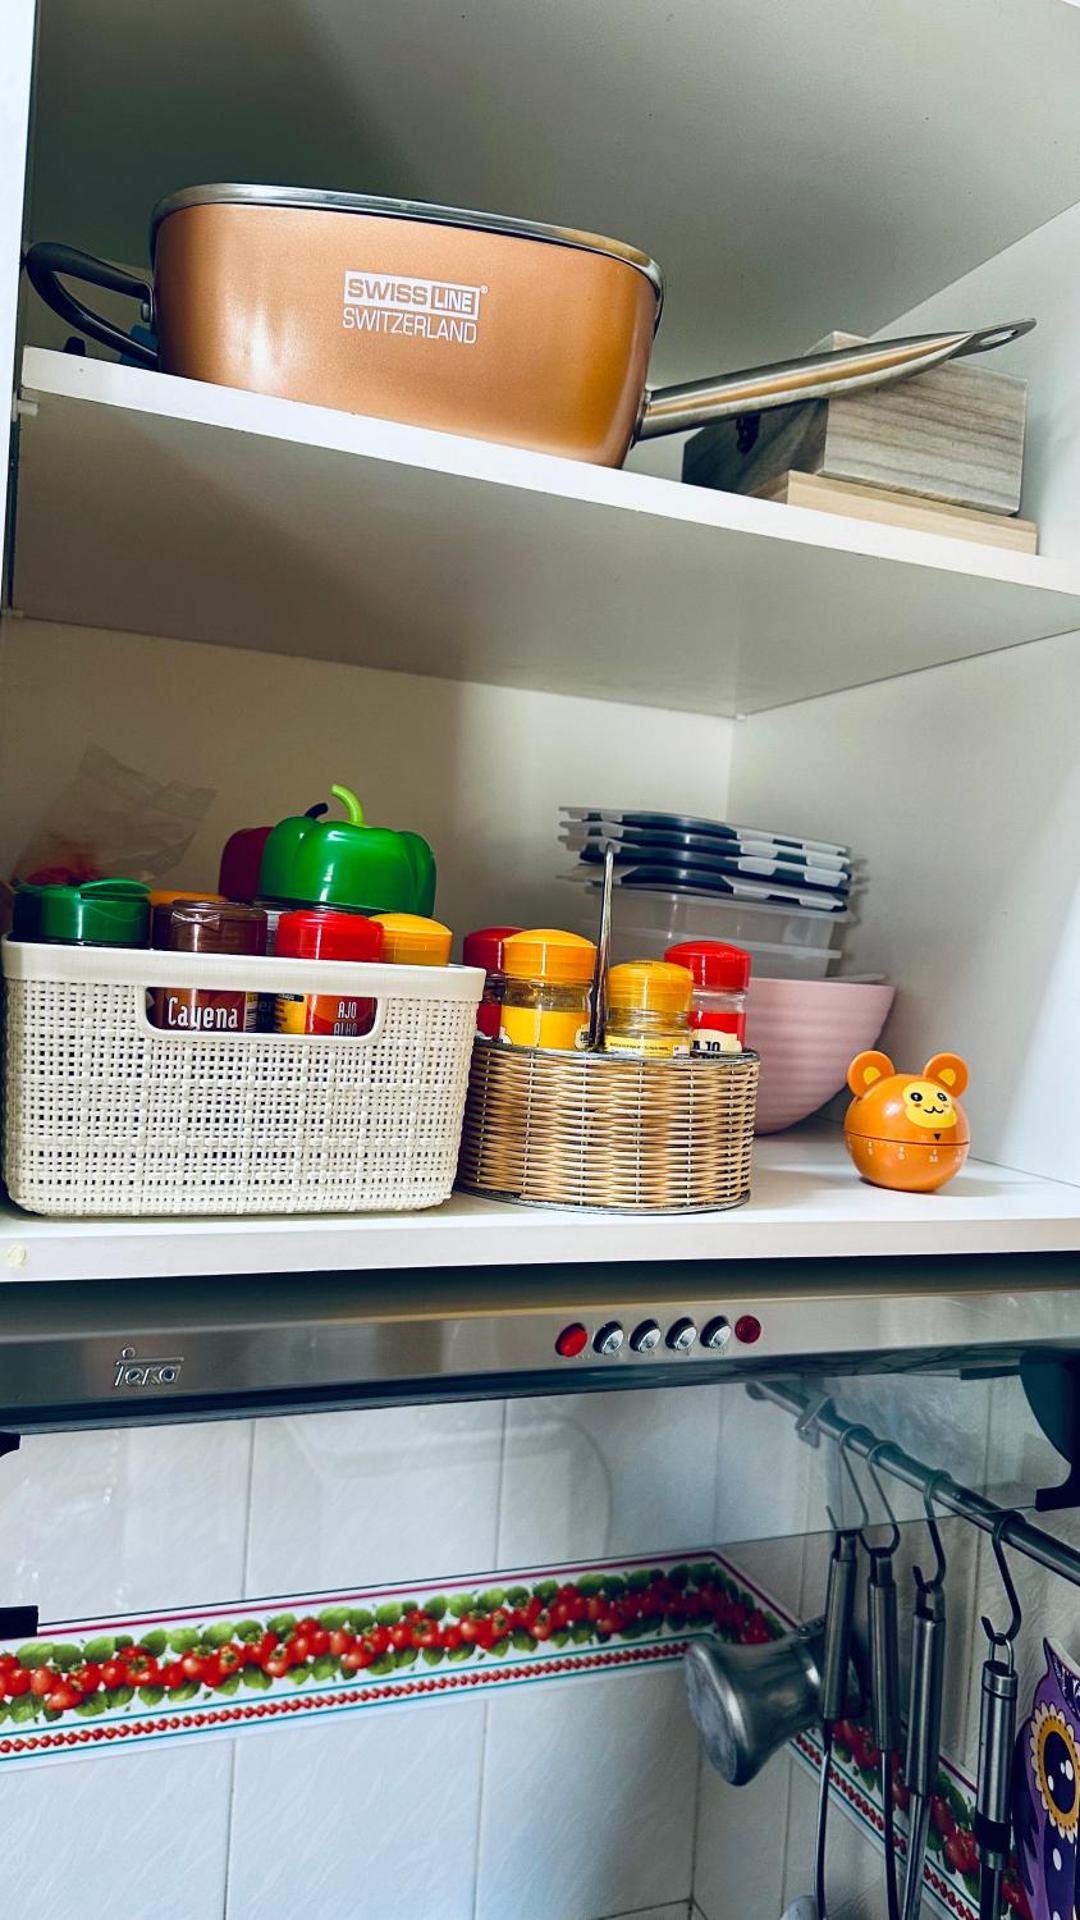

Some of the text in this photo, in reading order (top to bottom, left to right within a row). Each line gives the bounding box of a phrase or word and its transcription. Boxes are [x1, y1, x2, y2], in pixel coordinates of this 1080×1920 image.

[347, 278, 474, 313] SWISS LINE
[342, 306, 478, 344] SWITZERLAND
[168, 996, 239, 1032] Cayena
[337, 1001, 357, 1019] AJO
